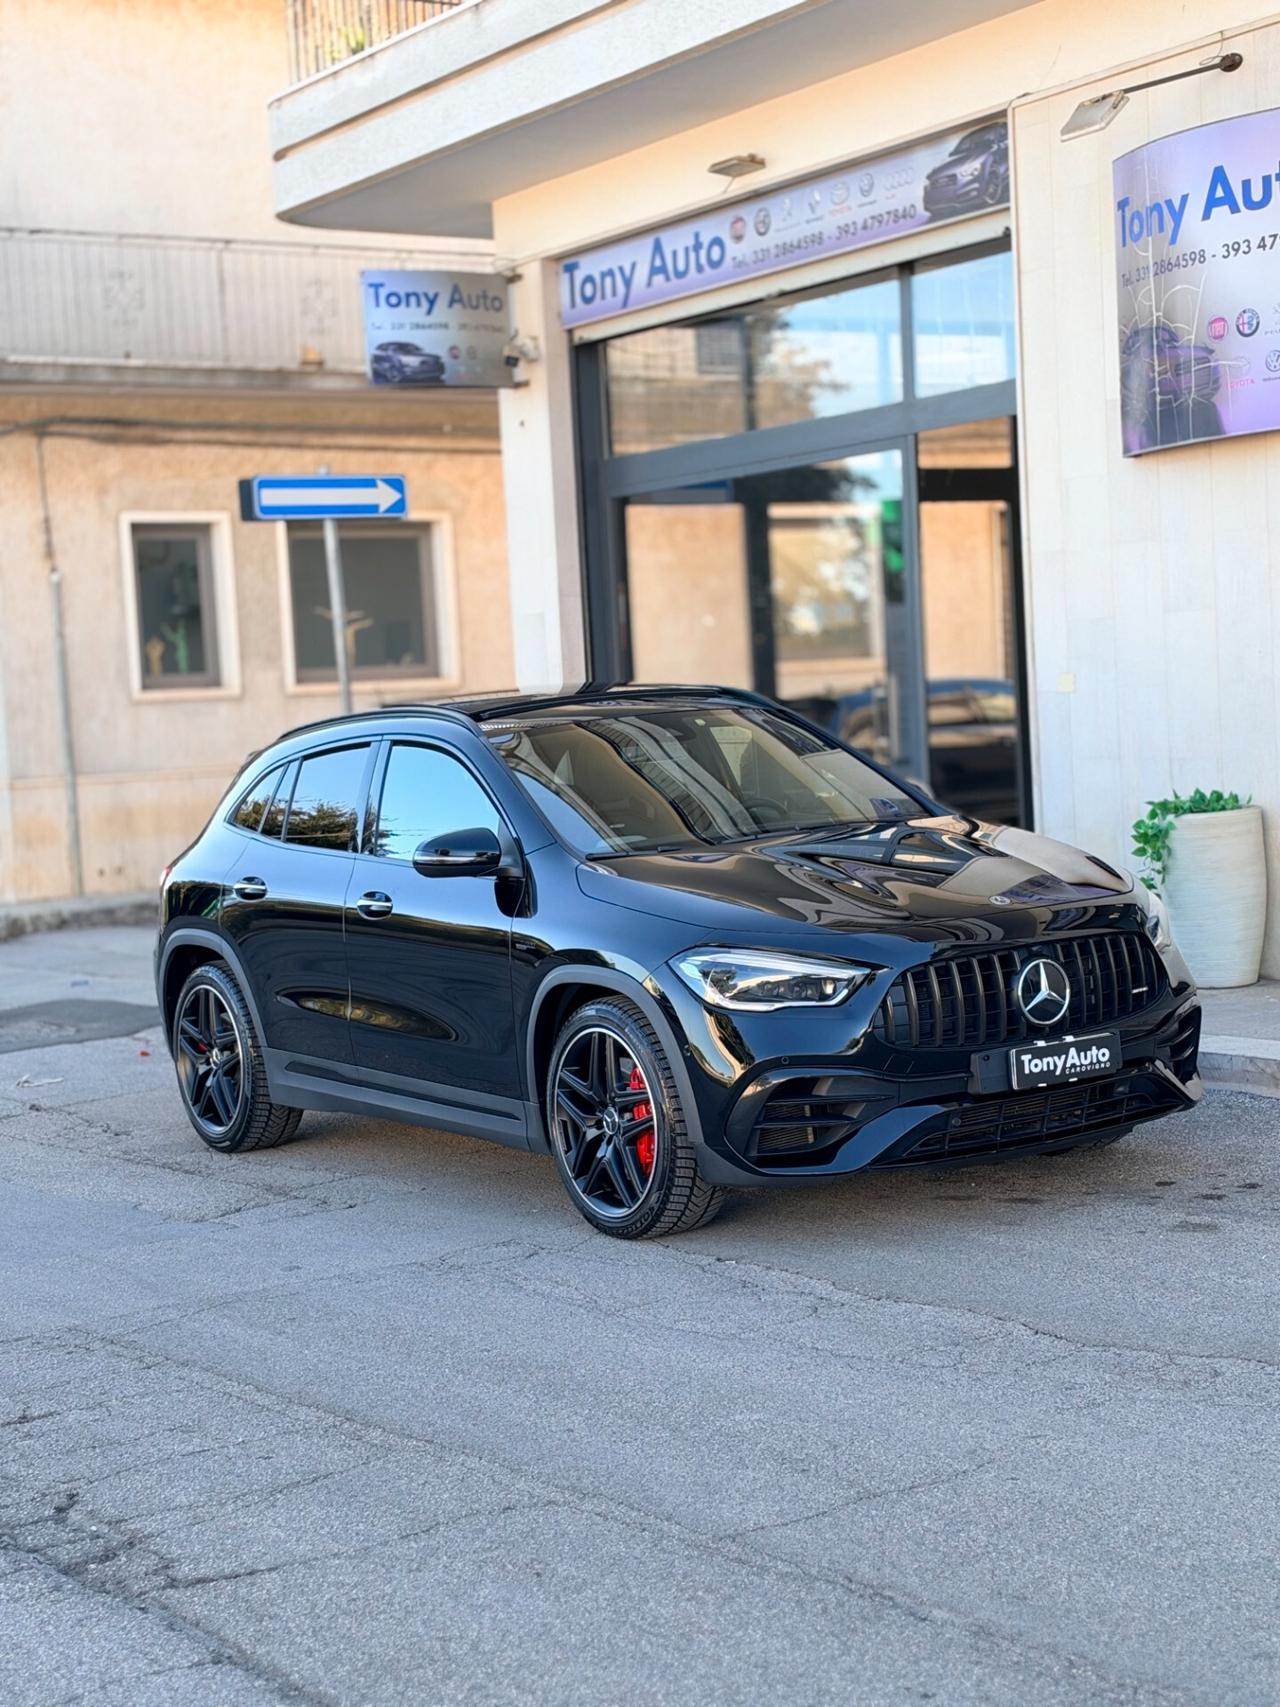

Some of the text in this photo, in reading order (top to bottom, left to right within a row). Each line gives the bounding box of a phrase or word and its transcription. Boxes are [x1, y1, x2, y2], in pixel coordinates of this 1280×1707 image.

[835, 222, 858, 242] 393
[861, 203, 917, 232] 4797840
[1117, 193, 1190, 248] Tony
[563, 231, 726, 310] Tony Auto
[1153, 248, 1207, 277] 2864598
[1221, 238, 1251, 259] 393
[367, 282, 504, 317] Tony Auto
[1021, 1046, 1110, 1075] TonyAuto
[1065, 1061, 1111, 1074] CAROVIGNO
